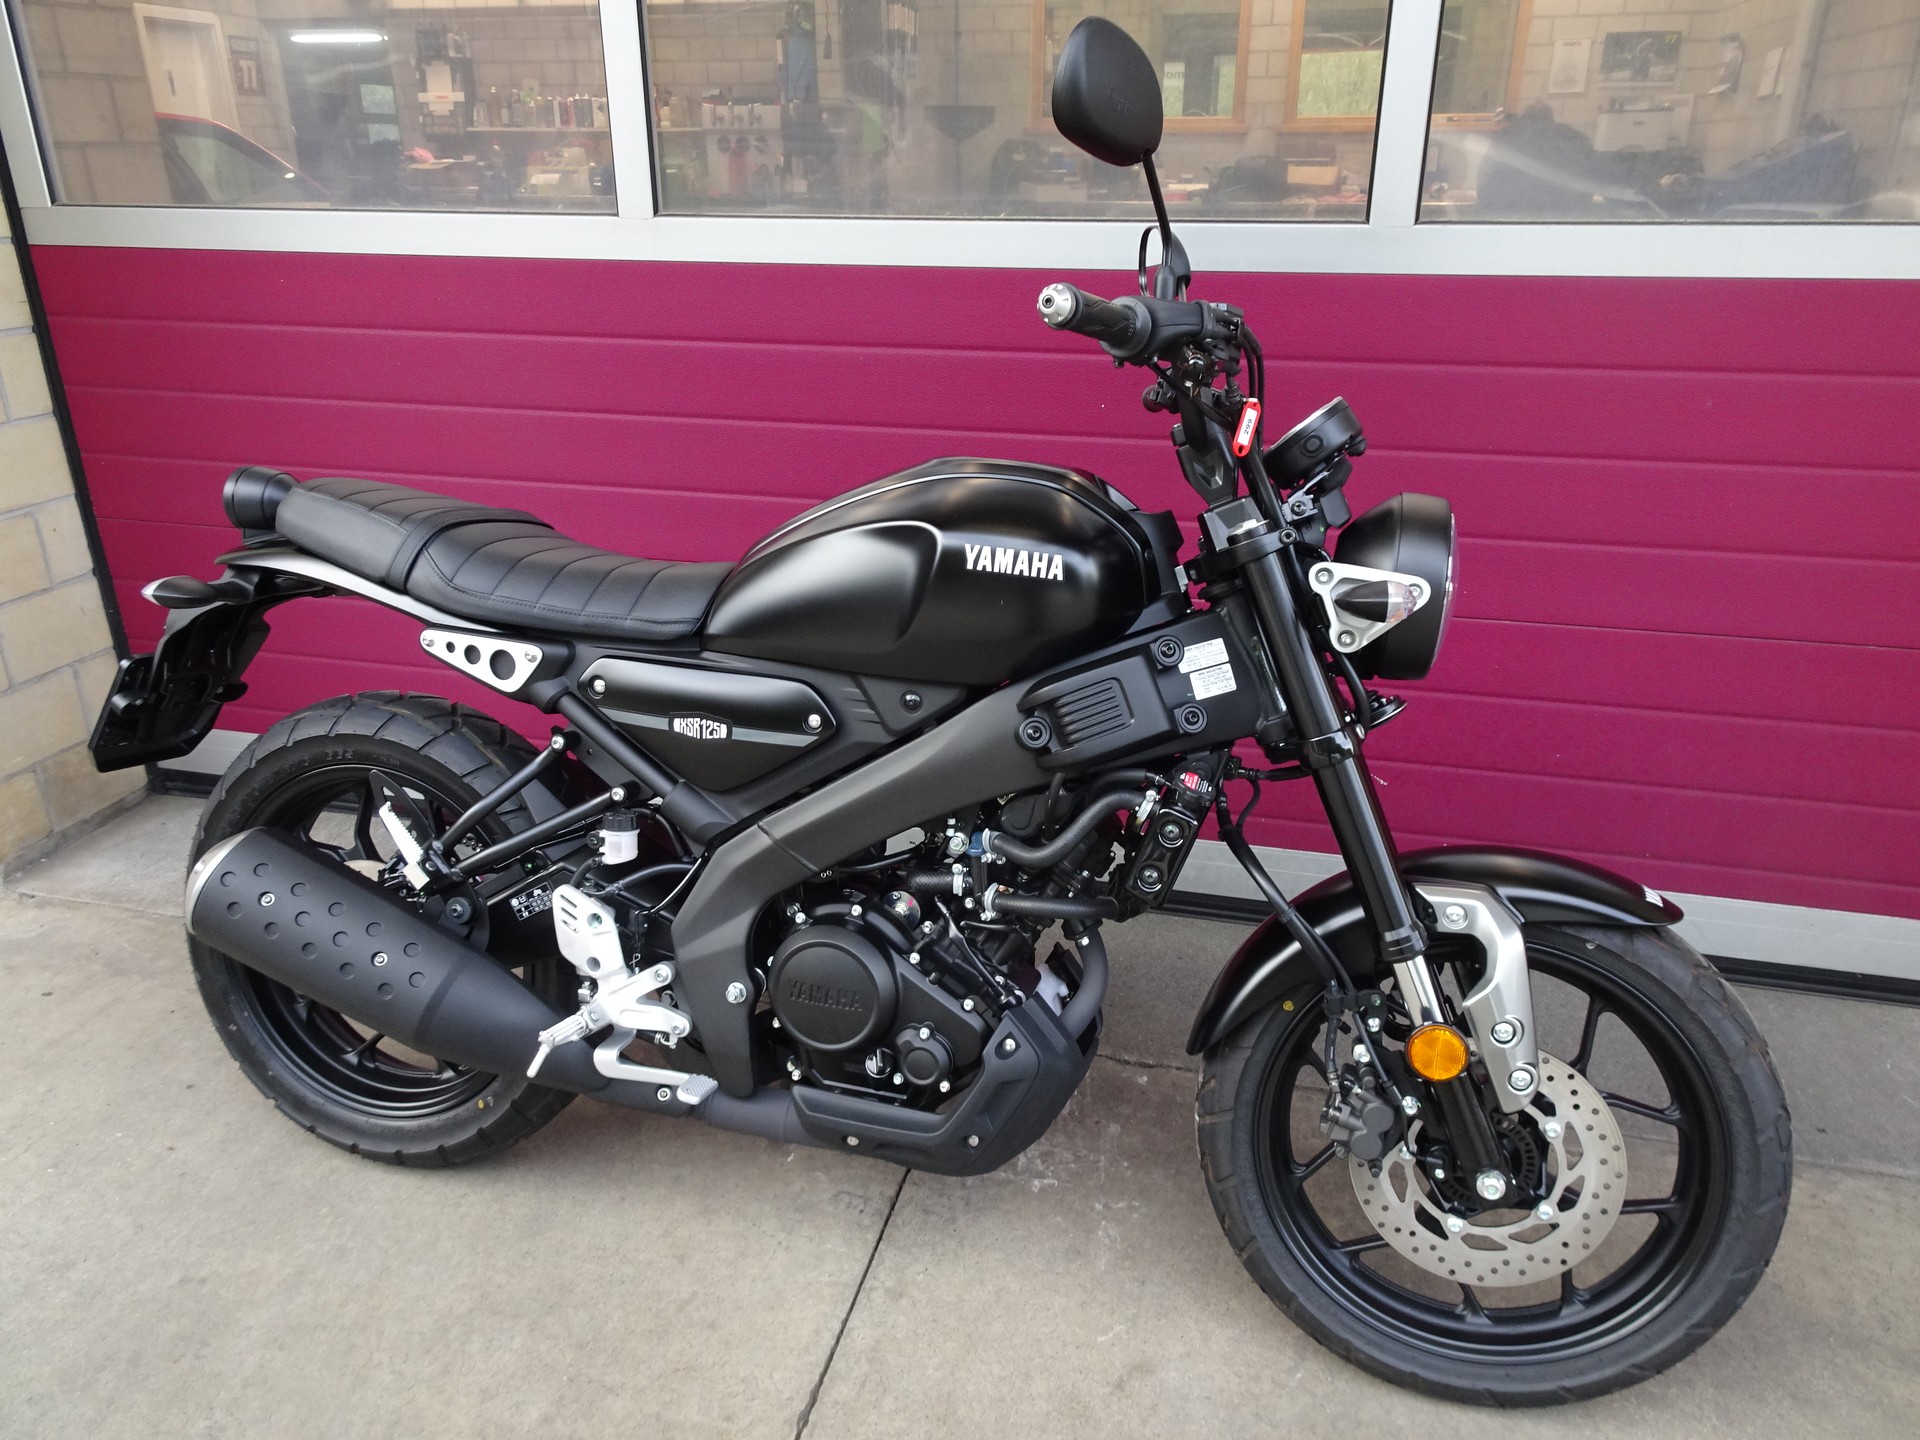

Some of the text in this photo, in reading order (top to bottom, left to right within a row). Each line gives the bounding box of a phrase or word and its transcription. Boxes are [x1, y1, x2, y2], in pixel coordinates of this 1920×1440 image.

[1243, 418, 1253, 436] 299
[964, 543, 1064, 581] YAMAHA
[679, 717, 721, 740] XSR125
[788, 979, 864, 1012] YAMAHA
